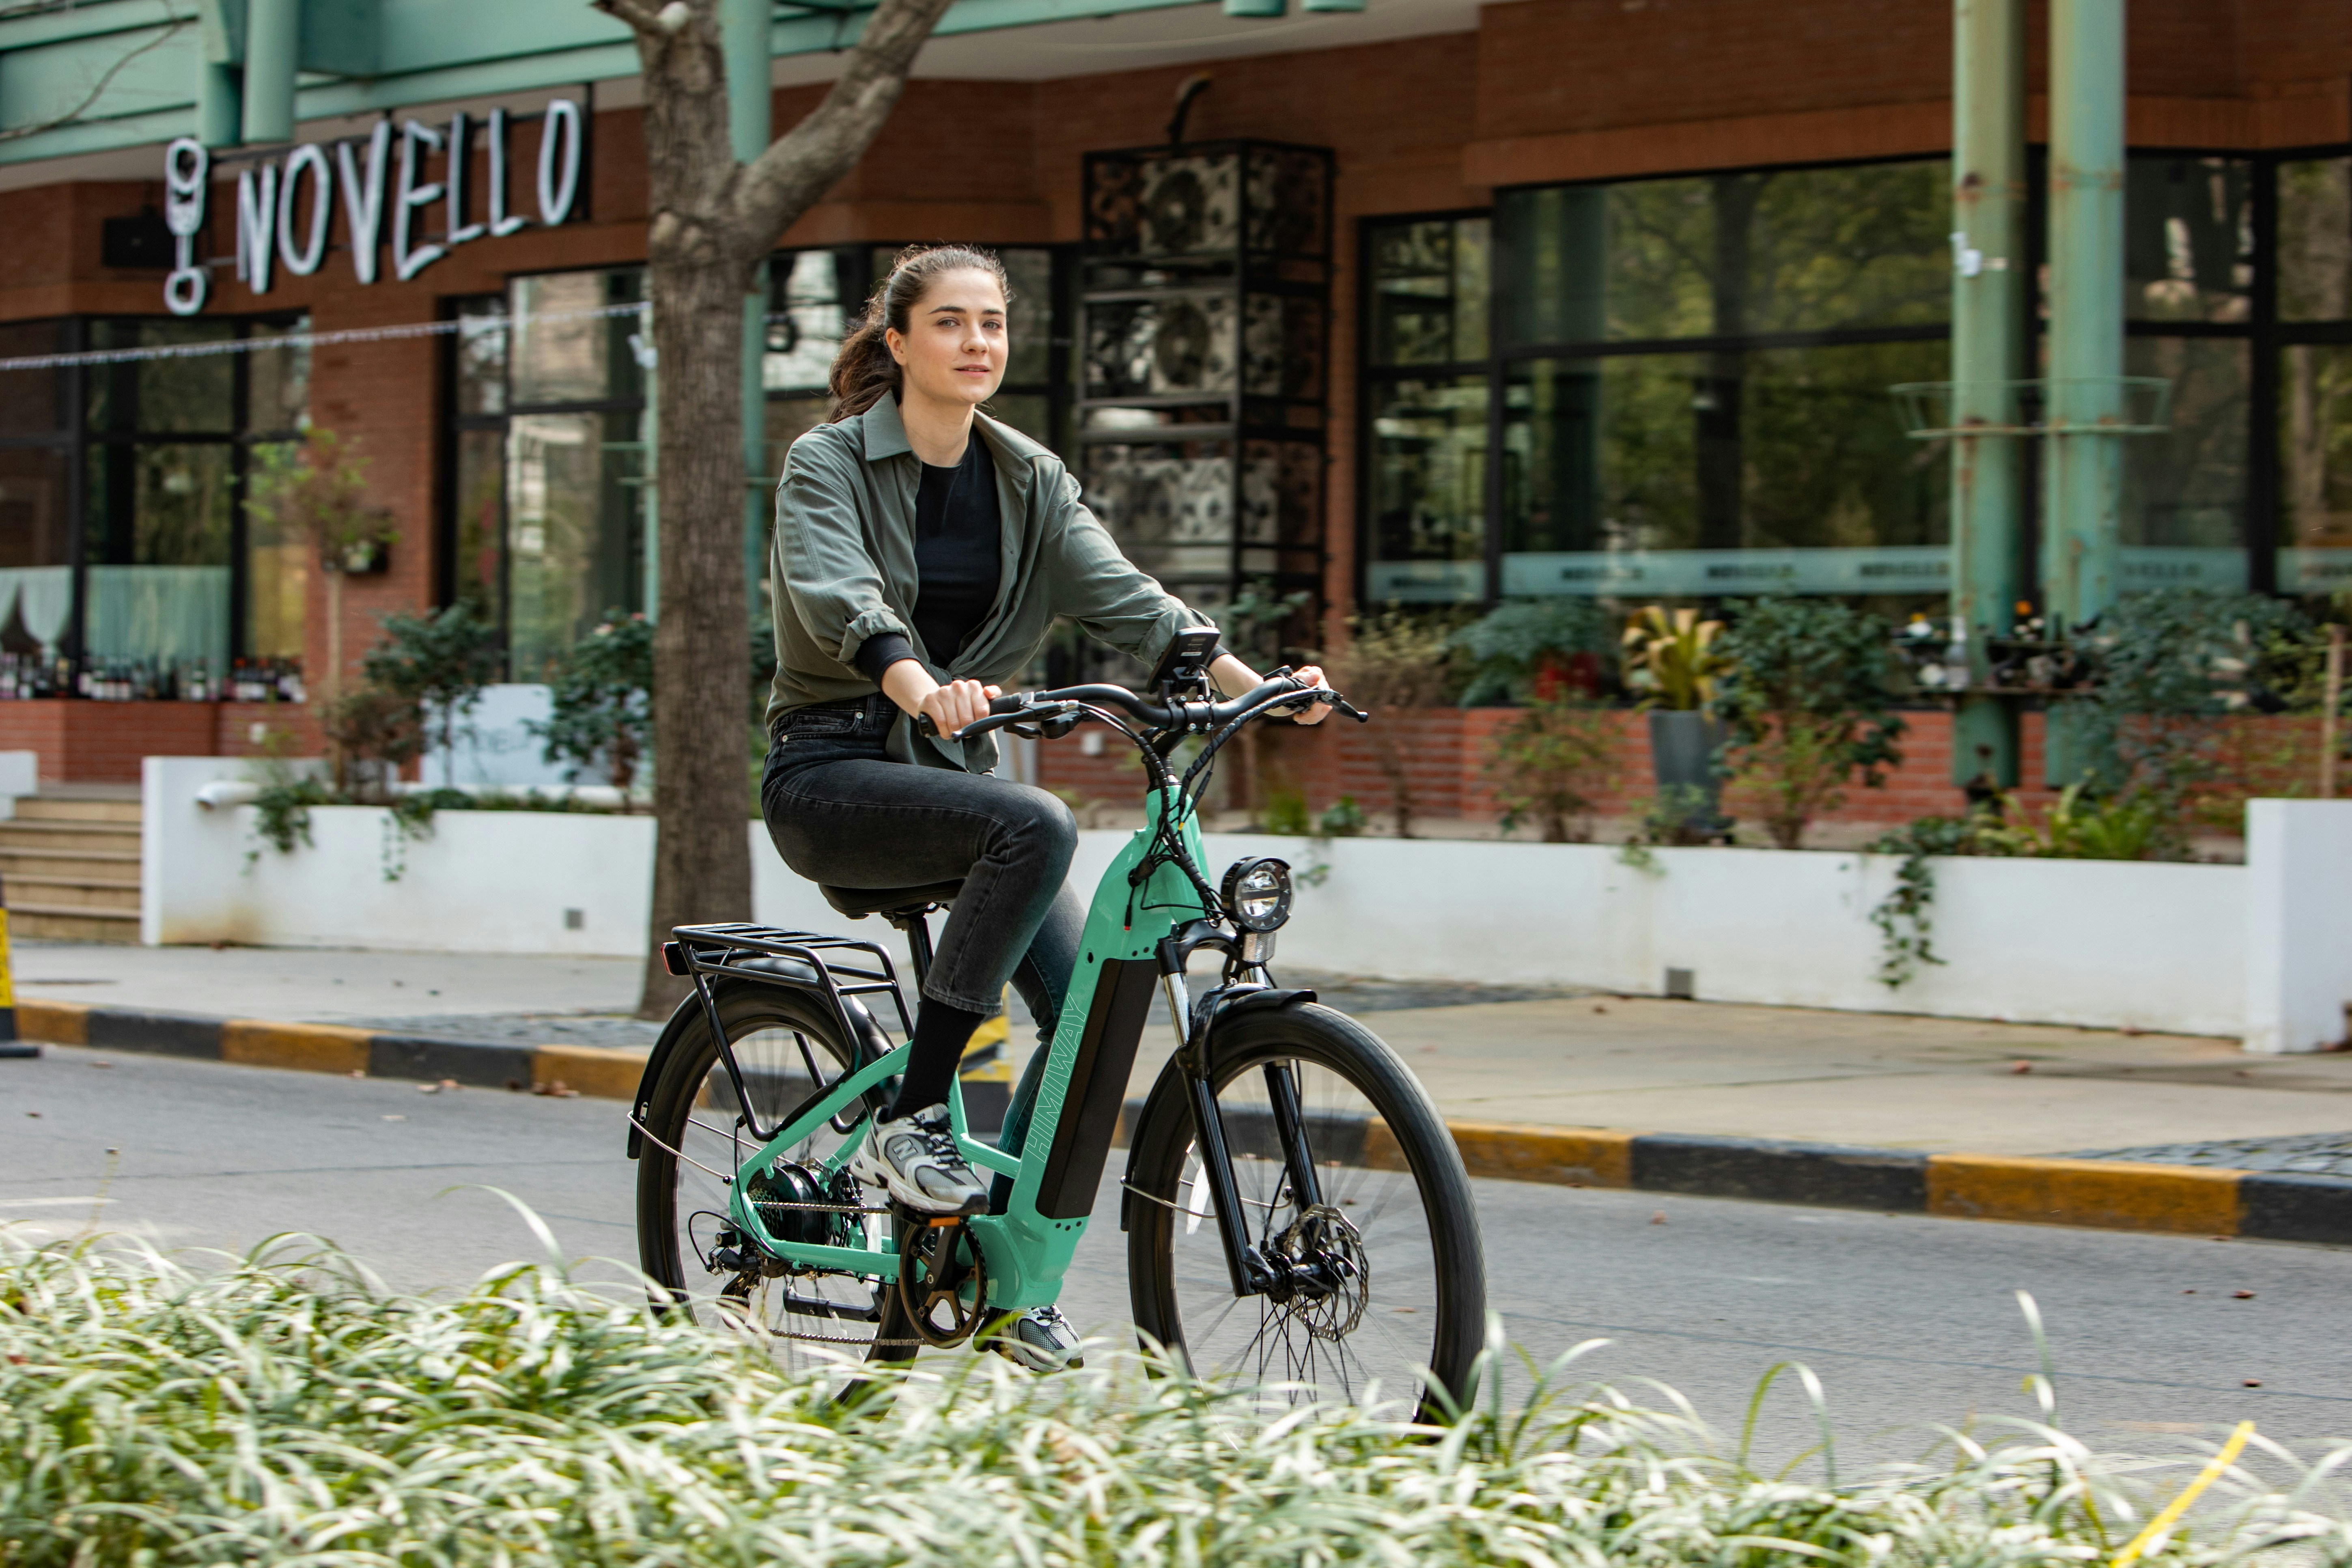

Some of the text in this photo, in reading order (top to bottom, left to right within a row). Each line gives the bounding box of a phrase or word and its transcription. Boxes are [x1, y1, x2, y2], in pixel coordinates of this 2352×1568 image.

[236, 99, 582, 294] NOVELLO
[893, 1139, 918, 1161] N
[1025, 993, 1086, 1163] HIMIWAY
